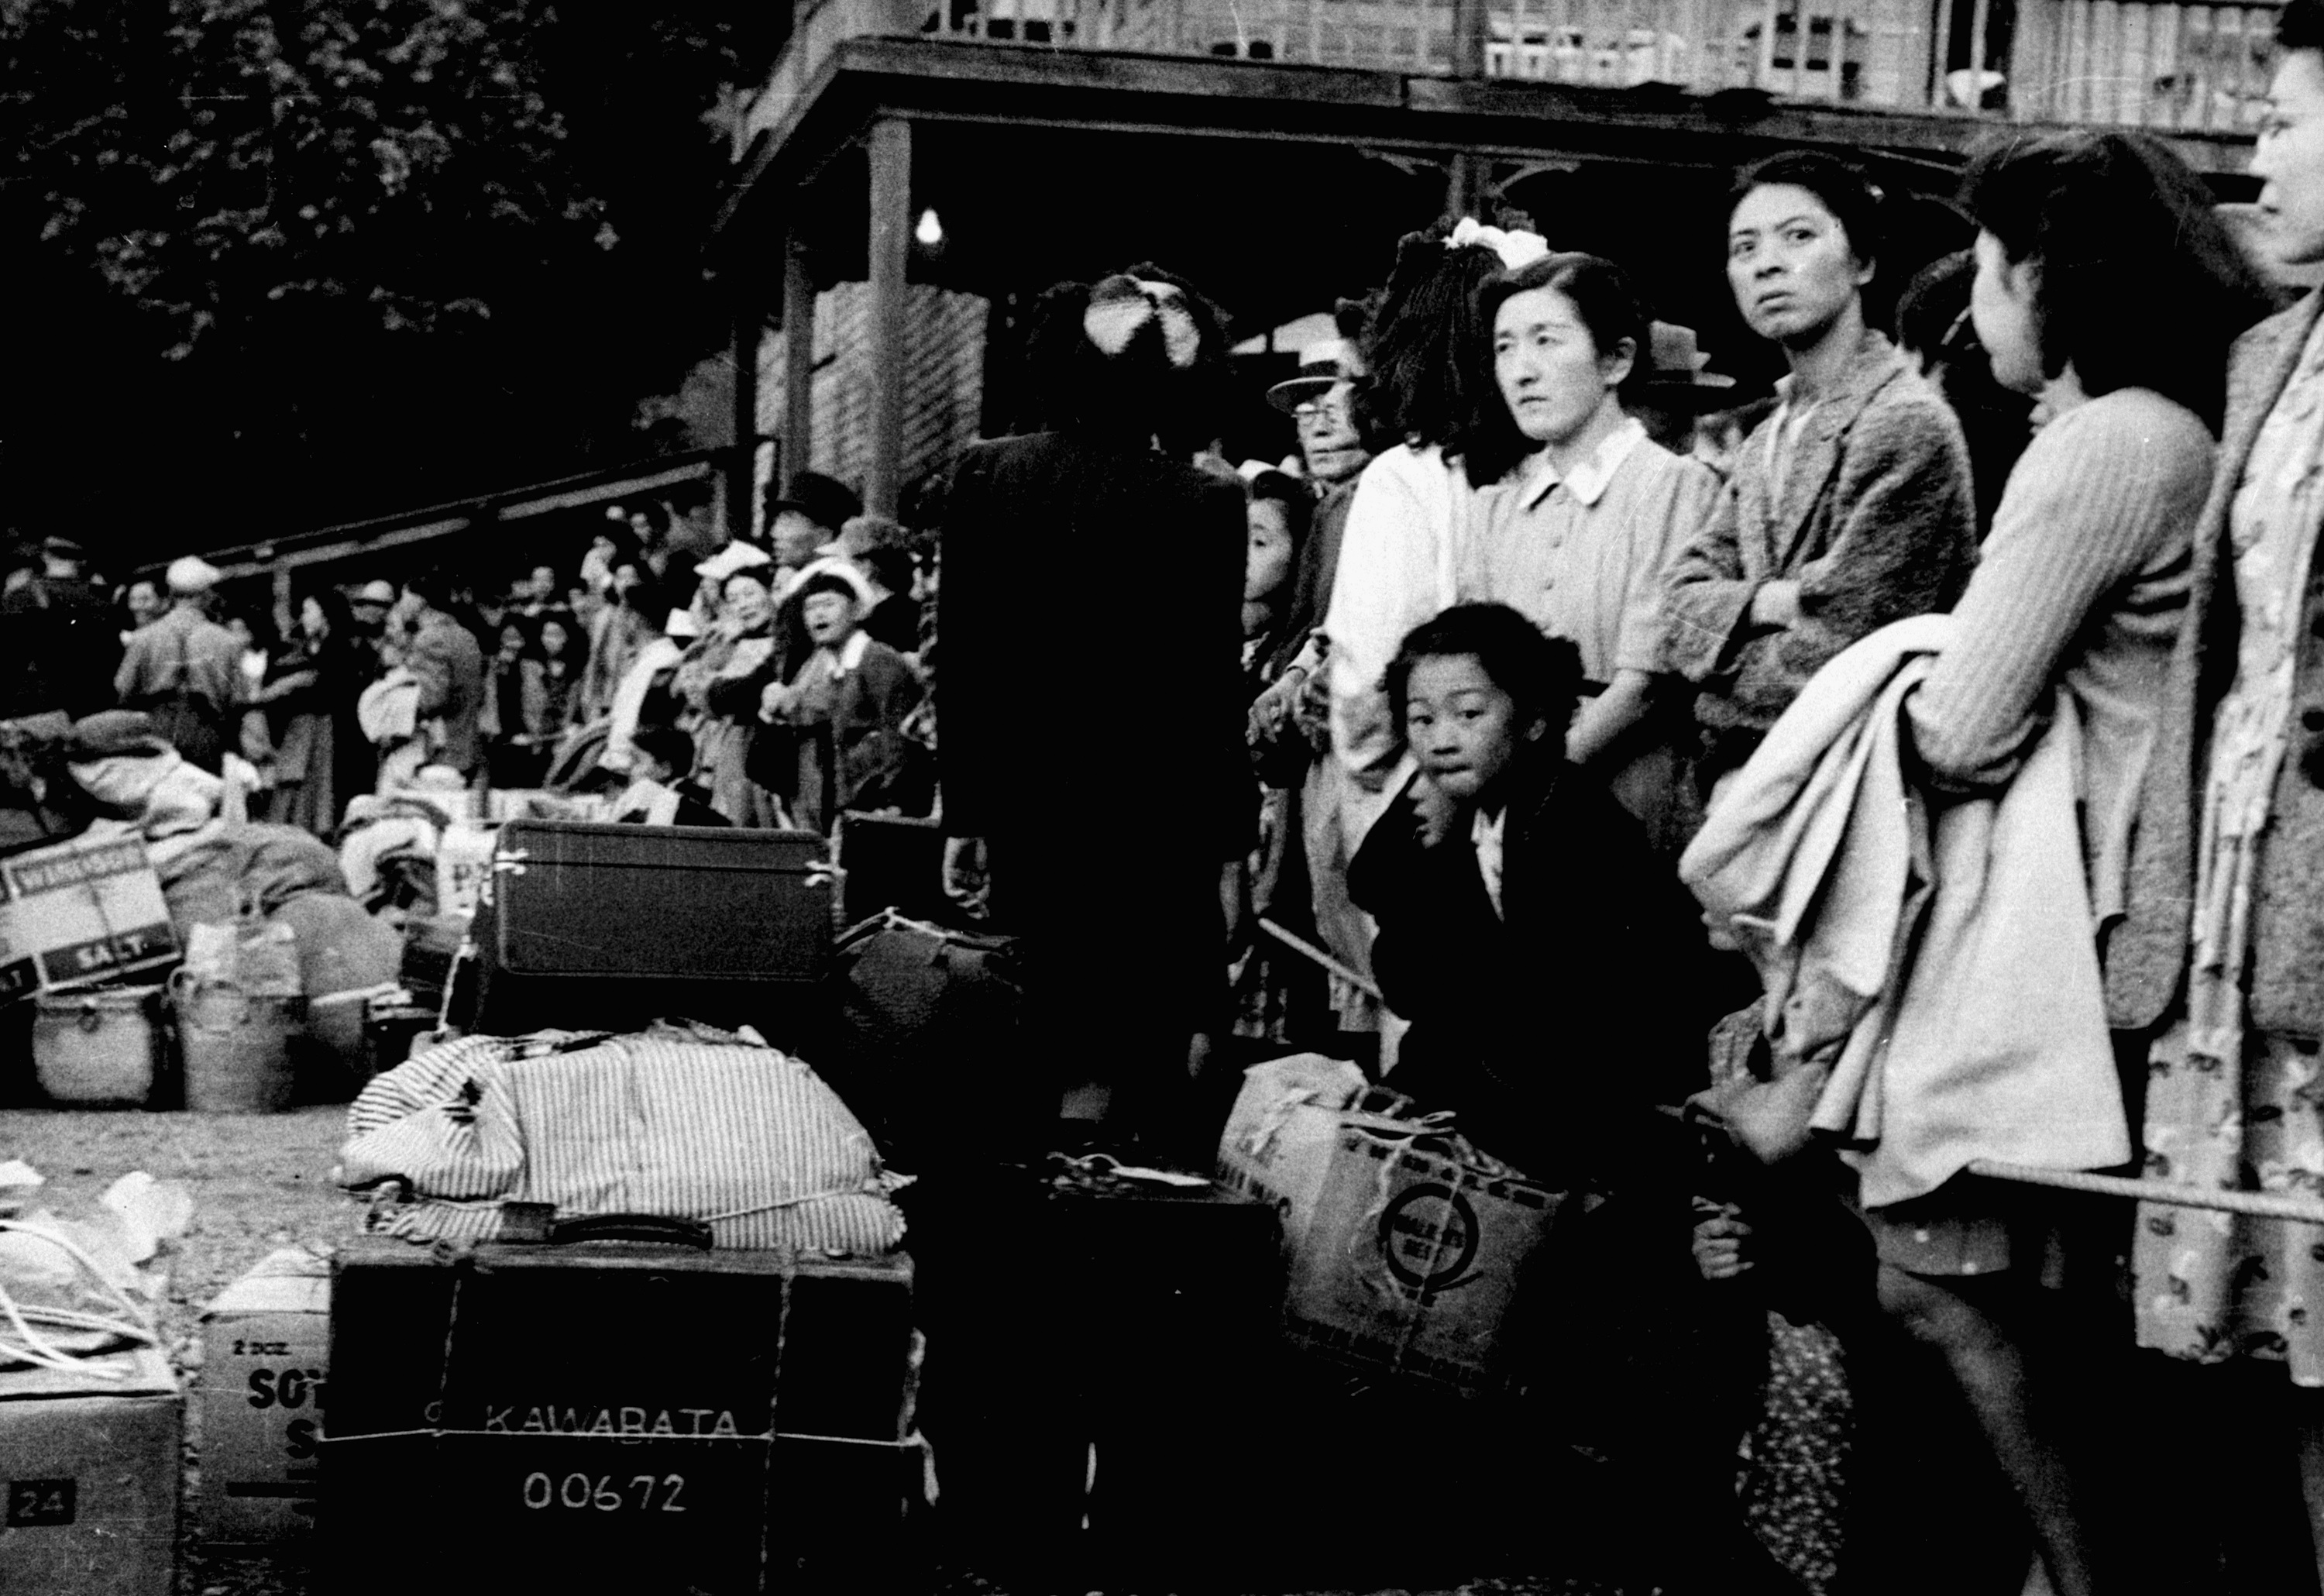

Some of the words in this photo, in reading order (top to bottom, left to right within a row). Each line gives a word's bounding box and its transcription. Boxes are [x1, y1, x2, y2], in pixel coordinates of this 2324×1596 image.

[486, 1404, 742, 1446] KAWABATA
[16, 1489, 65, 1519] 24
[523, 1472, 687, 1512] 00672
